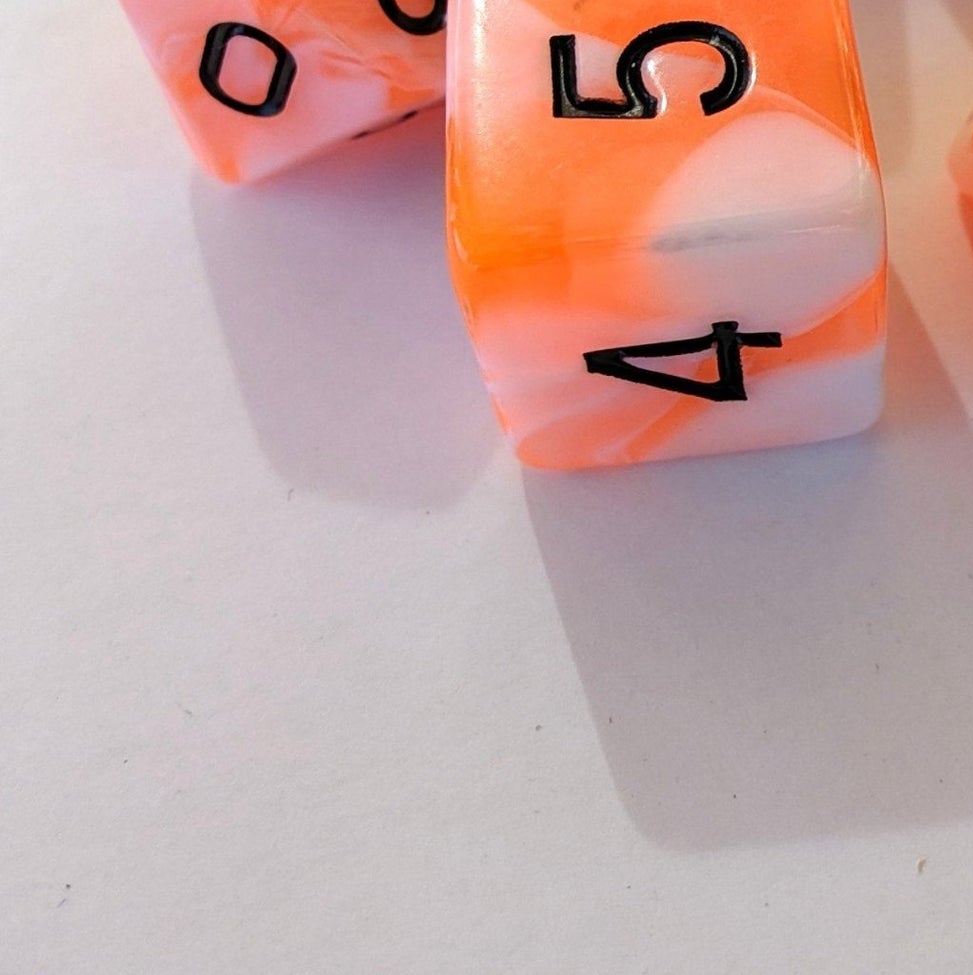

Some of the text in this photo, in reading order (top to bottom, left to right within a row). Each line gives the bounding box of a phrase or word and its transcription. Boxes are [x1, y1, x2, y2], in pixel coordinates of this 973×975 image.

[198, 21, 297, 117] 0
[549, 20, 750, 119] 5
[583, 320, 782, 403] 4
